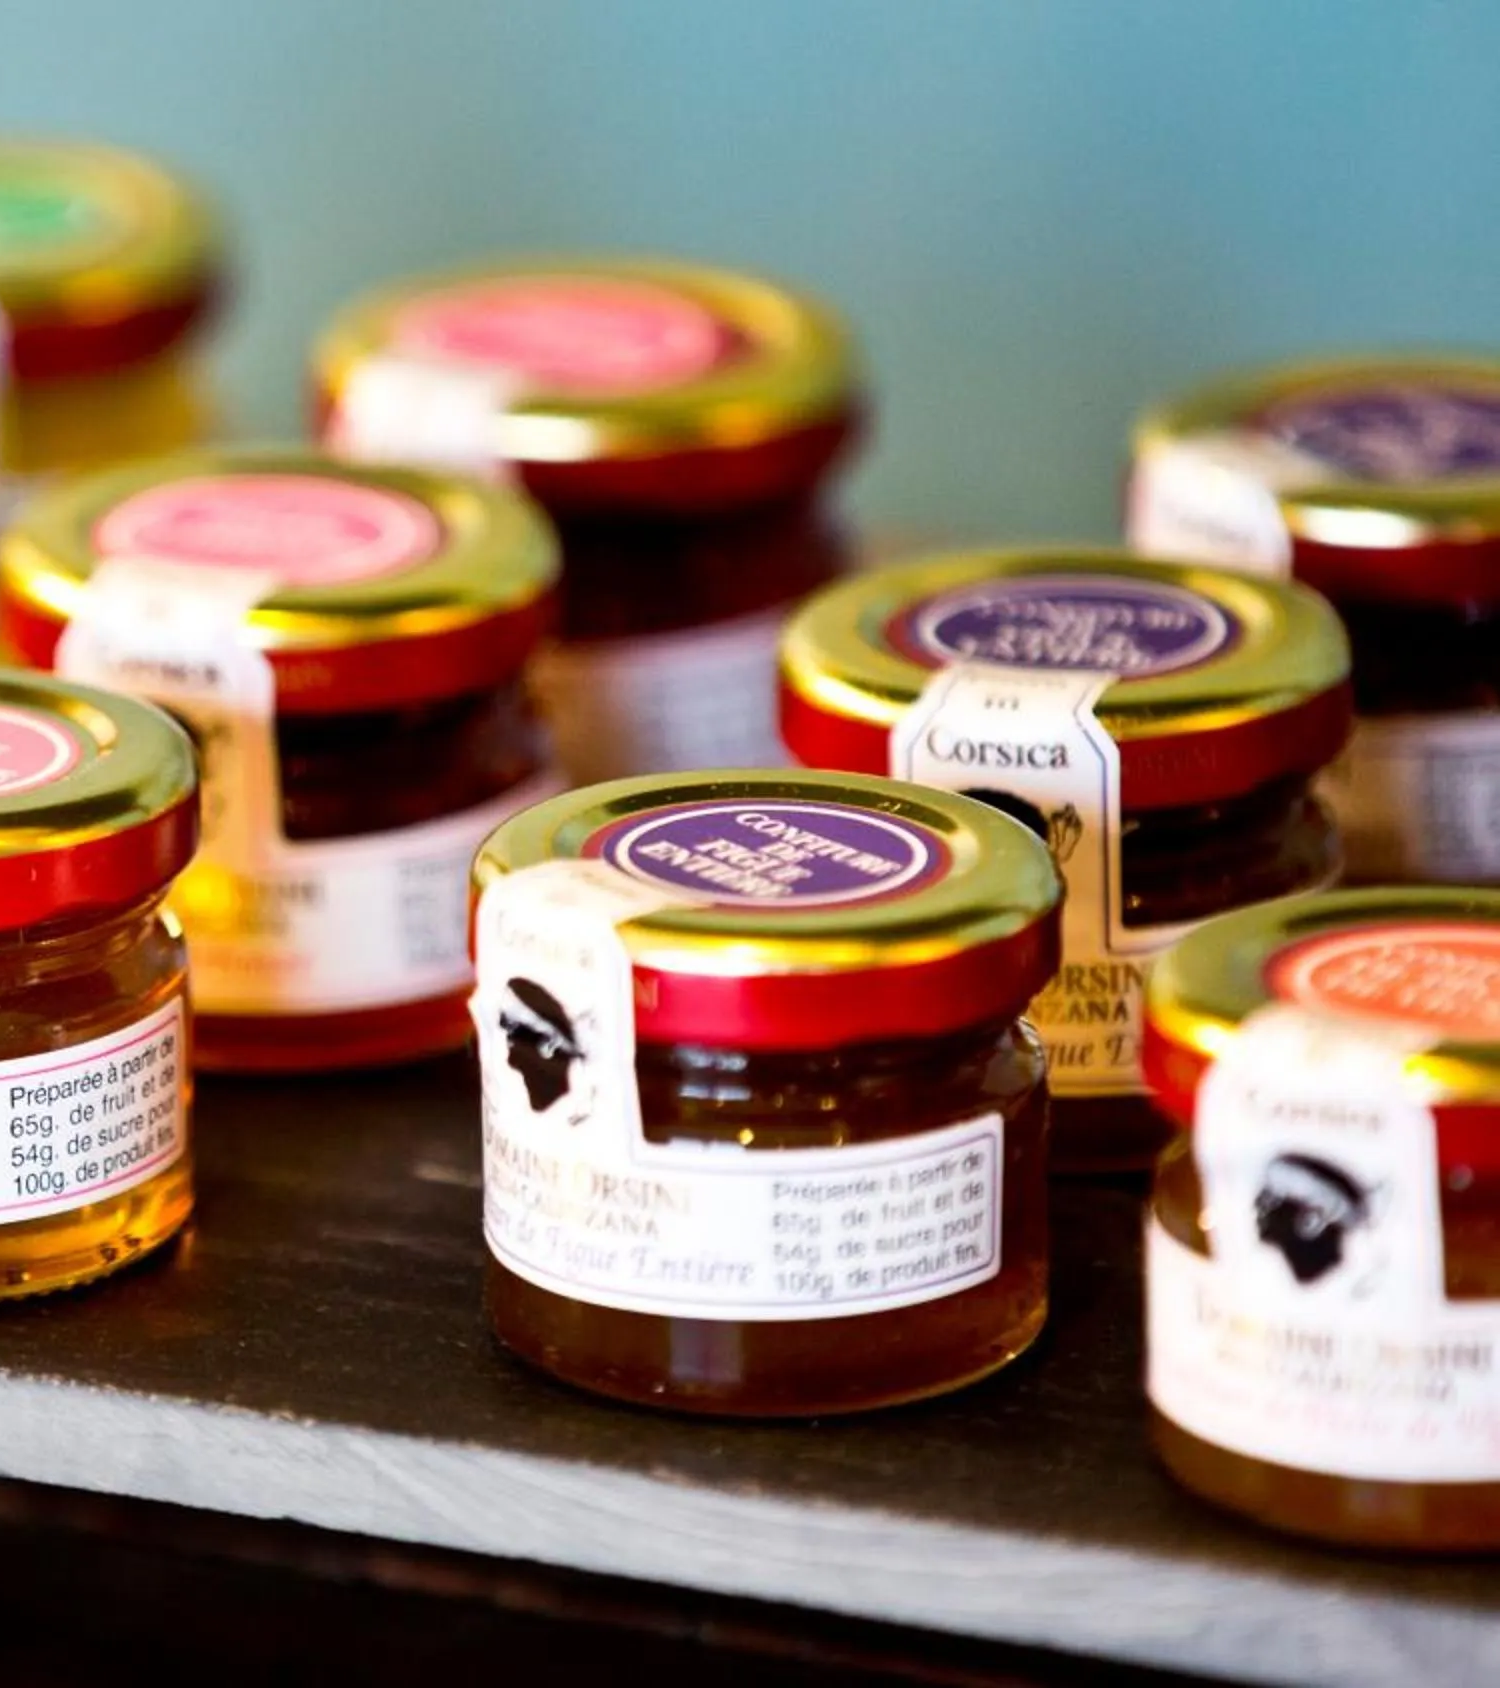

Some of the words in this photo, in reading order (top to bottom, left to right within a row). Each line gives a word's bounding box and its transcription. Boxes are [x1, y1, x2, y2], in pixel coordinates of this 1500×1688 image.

[927, 726, 1070, 769] Corsica
[736, 813, 903, 876] CONFITURE
[9, 1069, 104, 1109] Préparée
[107, 1062, 118, 1085] à
[121, 1045, 159, 1079] partir
[160, 1035, 175, 1059] de
[9, 1113, 60, 1139] 65g.
[69, 1103, 95, 1126] de
[102, 1085, 136, 1116] fruit
[141, 1075, 156, 1098] et
[159, 1064, 175, 1089] de
[11, 1143, 60, 1168] 54g.
[67, 1133, 93, 1156] de
[98, 1114, 144, 1147] sucre
[13, 1170, 70, 1197] 100g.
[75, 1160, 99, 1184] de
[103, 1135, 155, 1180] produit
[962, 1151, 982, 1175] de
